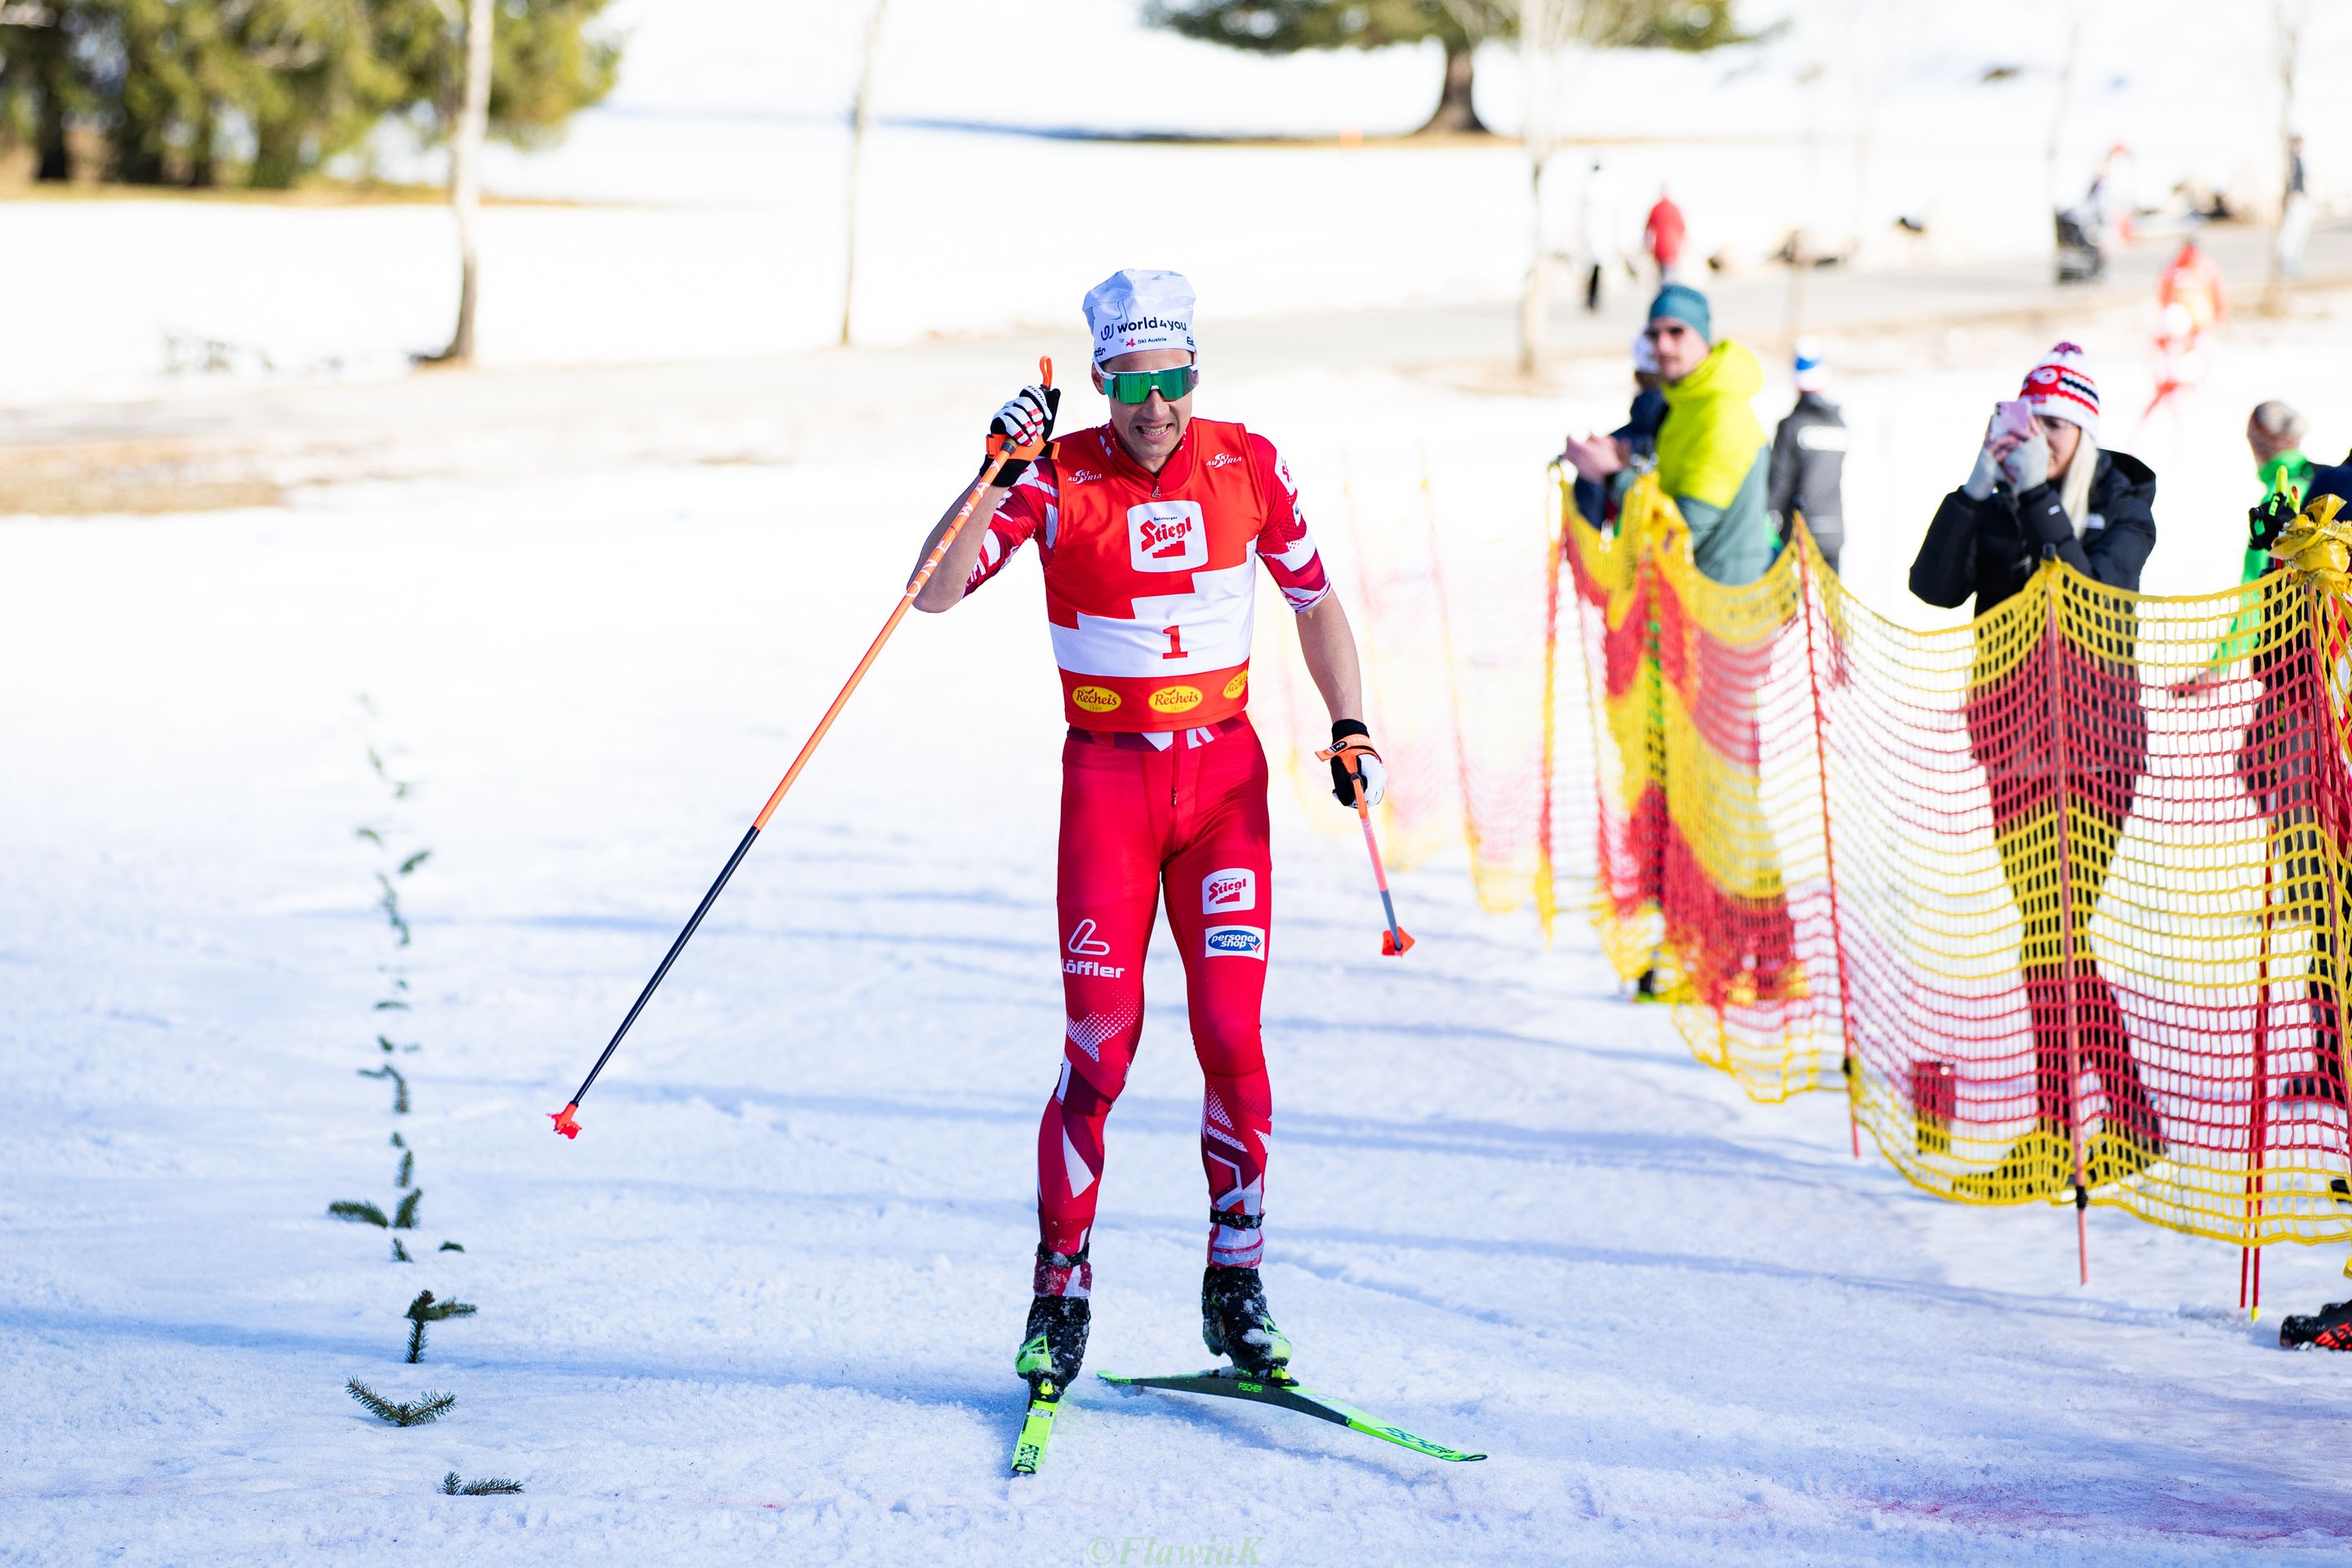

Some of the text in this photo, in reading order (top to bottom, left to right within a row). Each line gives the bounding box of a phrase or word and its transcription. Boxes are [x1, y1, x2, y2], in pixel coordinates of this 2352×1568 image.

[1117, 316, 1187, 333] world4you
[1140, 516, 1192, 552] Stiegl
[1163, 626, 1188, 659] 1
[1076, 690, 1117, 706] Recheis
[1155, 692, 1198, 706] Recheis
[1209, 878, 1246, 902] Stiegl
[1211, 934, 1256, 943] personal
[1220, 938, 1246, 948] shop
